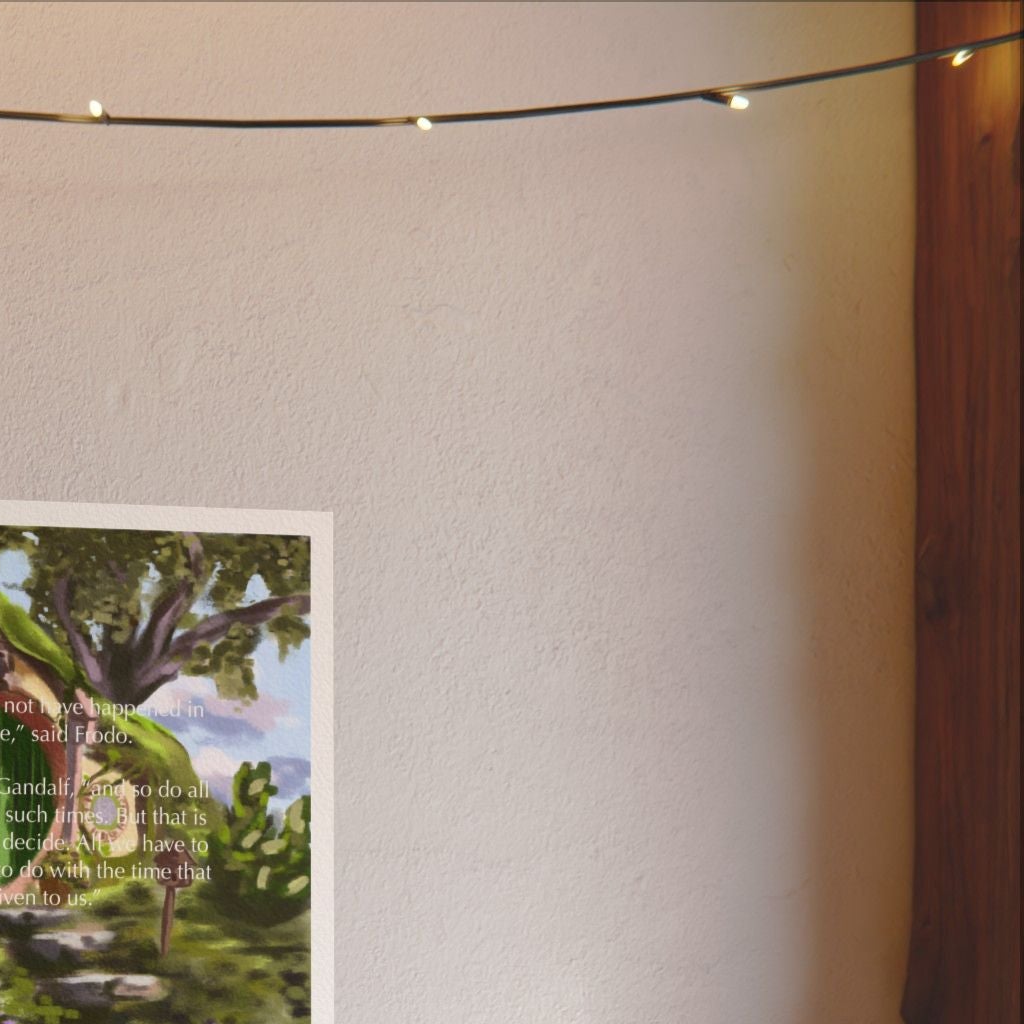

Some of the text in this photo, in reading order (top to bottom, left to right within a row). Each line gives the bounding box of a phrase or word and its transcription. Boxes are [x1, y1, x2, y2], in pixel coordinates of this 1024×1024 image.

[4, 698, 33, 713] not
[90, 697, 181, 720] happened
[188, 701, 204, 717] in
[31, 725, 68, 742] said
[76, 726, 133, 744] Frodo.
[134, 783, 152, 797] so
[158, 780, 181, 798] do
[188, 781, 209, 798] all
[6, 805, 47, 823] such
[55, 806, 108, 824] times.
[117, 808, 147, 824] But
[153, 807, 187, 825] that
[194, 808, 207, 825] is
[2, 832, 70, 851] decide.
[77, 834, 102, 851] All
[143, 834, 185, 852] have
[191, 838, 209, 852] to
[20, 860, 43, 878] do
[50, 860, 90, 879] with
[97, 861, 126, 879] the
[131, 862, 172, 880] time
[177, 861, 212, 880] that
[43, 891, 60, 905] to
[68, 889, 101, 906] us.”
